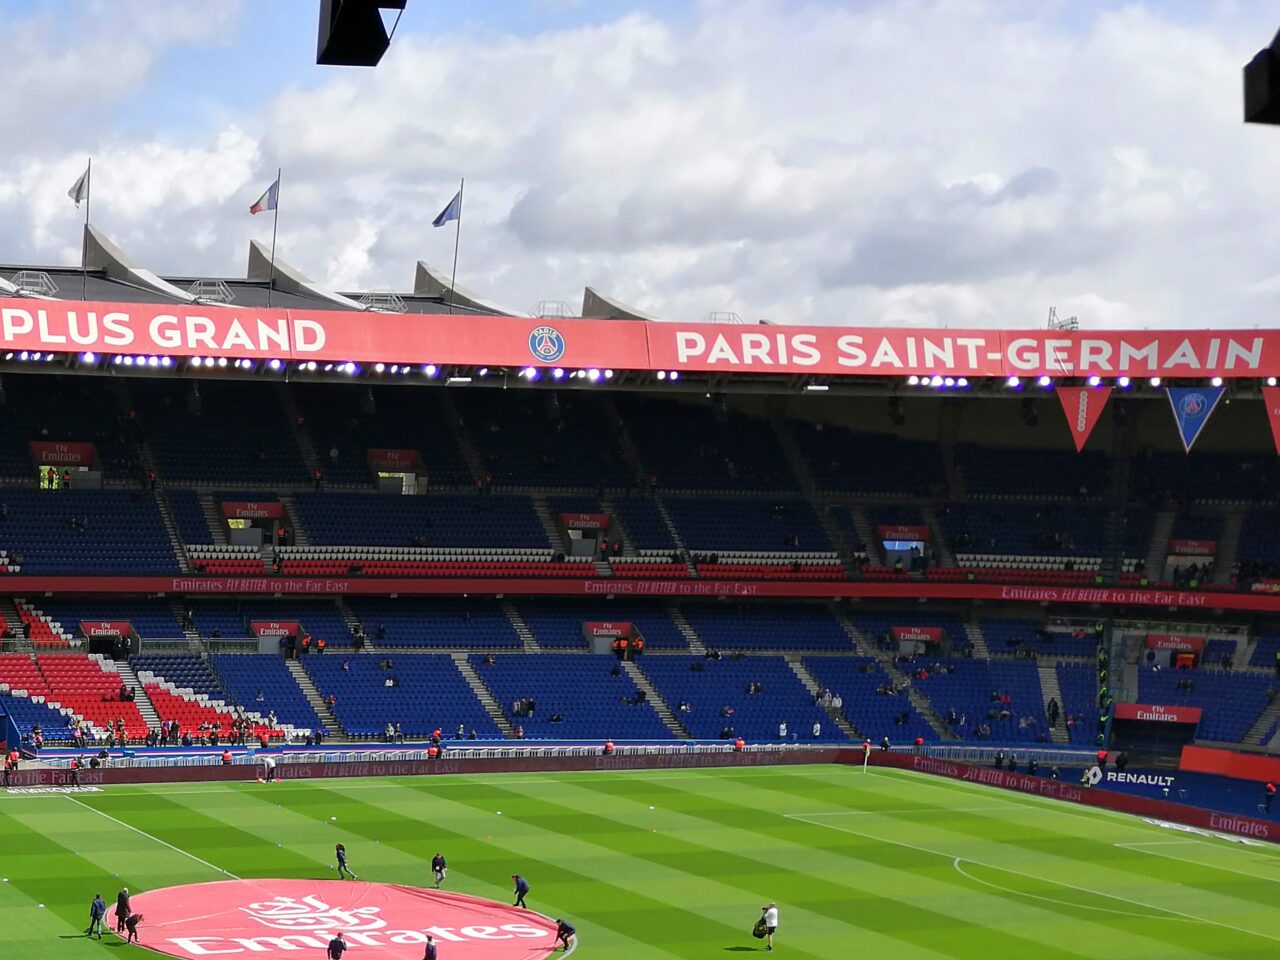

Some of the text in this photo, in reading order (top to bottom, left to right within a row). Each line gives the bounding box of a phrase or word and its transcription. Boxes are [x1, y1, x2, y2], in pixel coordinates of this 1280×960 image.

[2, 307, 135, 346] PLUS
[149, 313, 327, 353] GRAND
[675, 330, 1264, 371] PARIS SAINT-GERMAIN
[42, 451, 81, 461] Emirates
[236, 508, 268, 517] Emirates
[173, 579, 348, 591] Emirates FLY BETTER to the Far East
[584, 582, 633, 593] Emirates
[680, 583, 691, 593] to
[694, 582, 711, 593] the
[715, 583, 730, 593] Far
[735, 583, 757, 594] East
[1002, 587, 1057, 599] Emirates
[1112, 591, 1125, 602] to
[1129, 591, 1150, 603] the
[1155, 592, 1174, 604] Far
[1179, 593, 1205, 605] East
[91, 627, 120, 636] Emirates
[900, 632, 930, 640] Emirates
[1157, 640, 1191, 649] Emirates
[1137, 711, 1178, 722] Emirates
[372, 766, 385, 775] to
[389, 763, 407, 774] the
[412, 763, 429, 773] Far
[435, 762, 458, 772] East
[9, 773, 22, 784] to
[26, 771, 46, 784] the
[51, 771, 70, 784] Far
[914, 757, 958, 775] Emirates
[1006, 775, 1017, 786] to
[1020, 776, 1035, 790] the
[1040, 780, 1056, 794] Far
[1060, 784, 1081, 800] East
[1107, 771, 1174, 786] RENAULT
[1210, 813, 1268, 837] Emirates
[166, 921, 549, 956] Emirates
